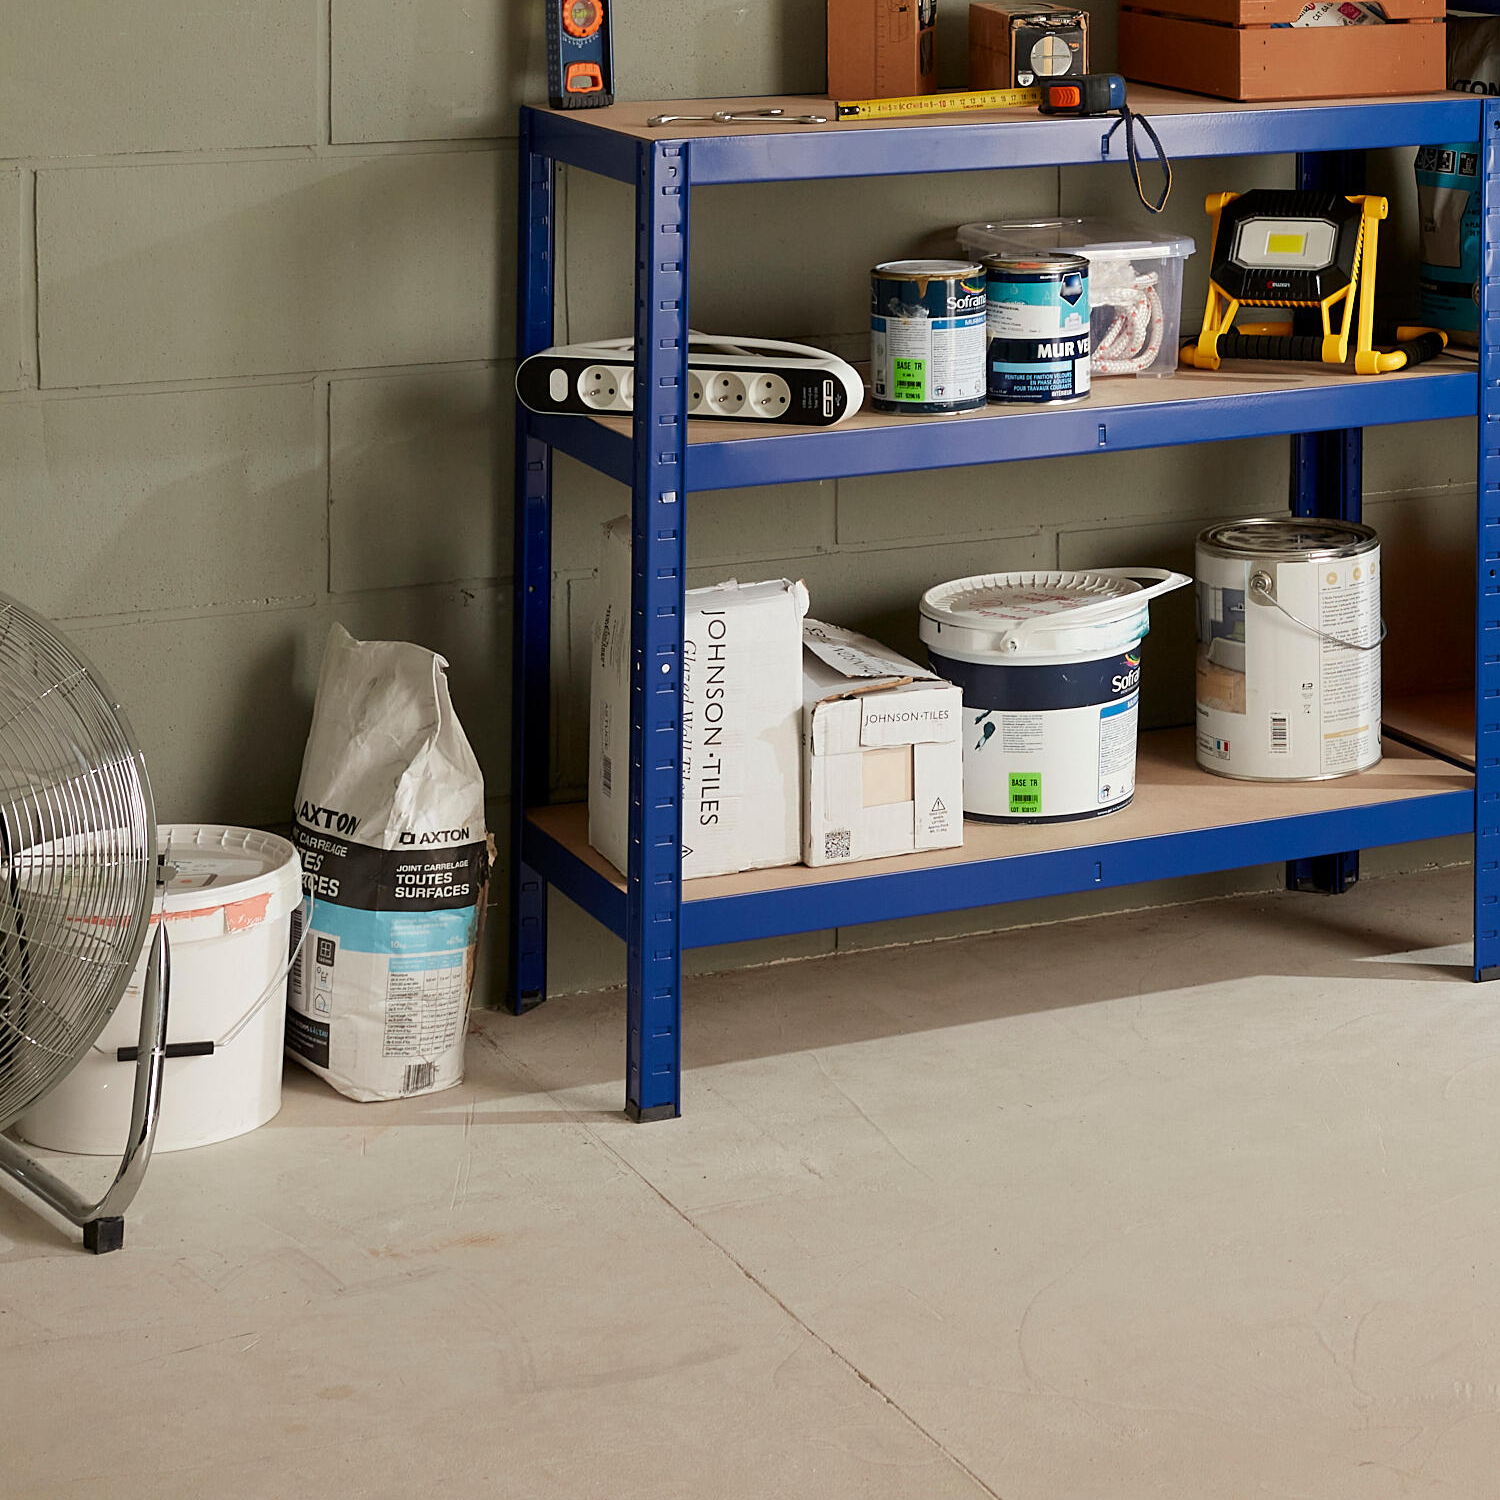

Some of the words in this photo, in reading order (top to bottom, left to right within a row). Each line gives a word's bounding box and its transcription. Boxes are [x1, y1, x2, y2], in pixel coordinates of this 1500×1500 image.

[939, 100, 947, 108] 10
[1037, 341, 1075, 359] MUR
[896, 361, 911, 370] BASE
[914, 362, 923, 370] TR
[1011, 778, 1027, 787] BASE
[1030, 778, 1038, 787] TR
[299, 800, 362, 836] AXTON
[419, 827, 470, 845] AXTON
[299, 832, 349, 858] CARRELAGE
[396, 864, 422, 873] JOINT
[423, 859, 469, 872] CARRELAGE
[395, 872, 453, 886] TOUTES
[394, 883, 470, 899] SURFACES
